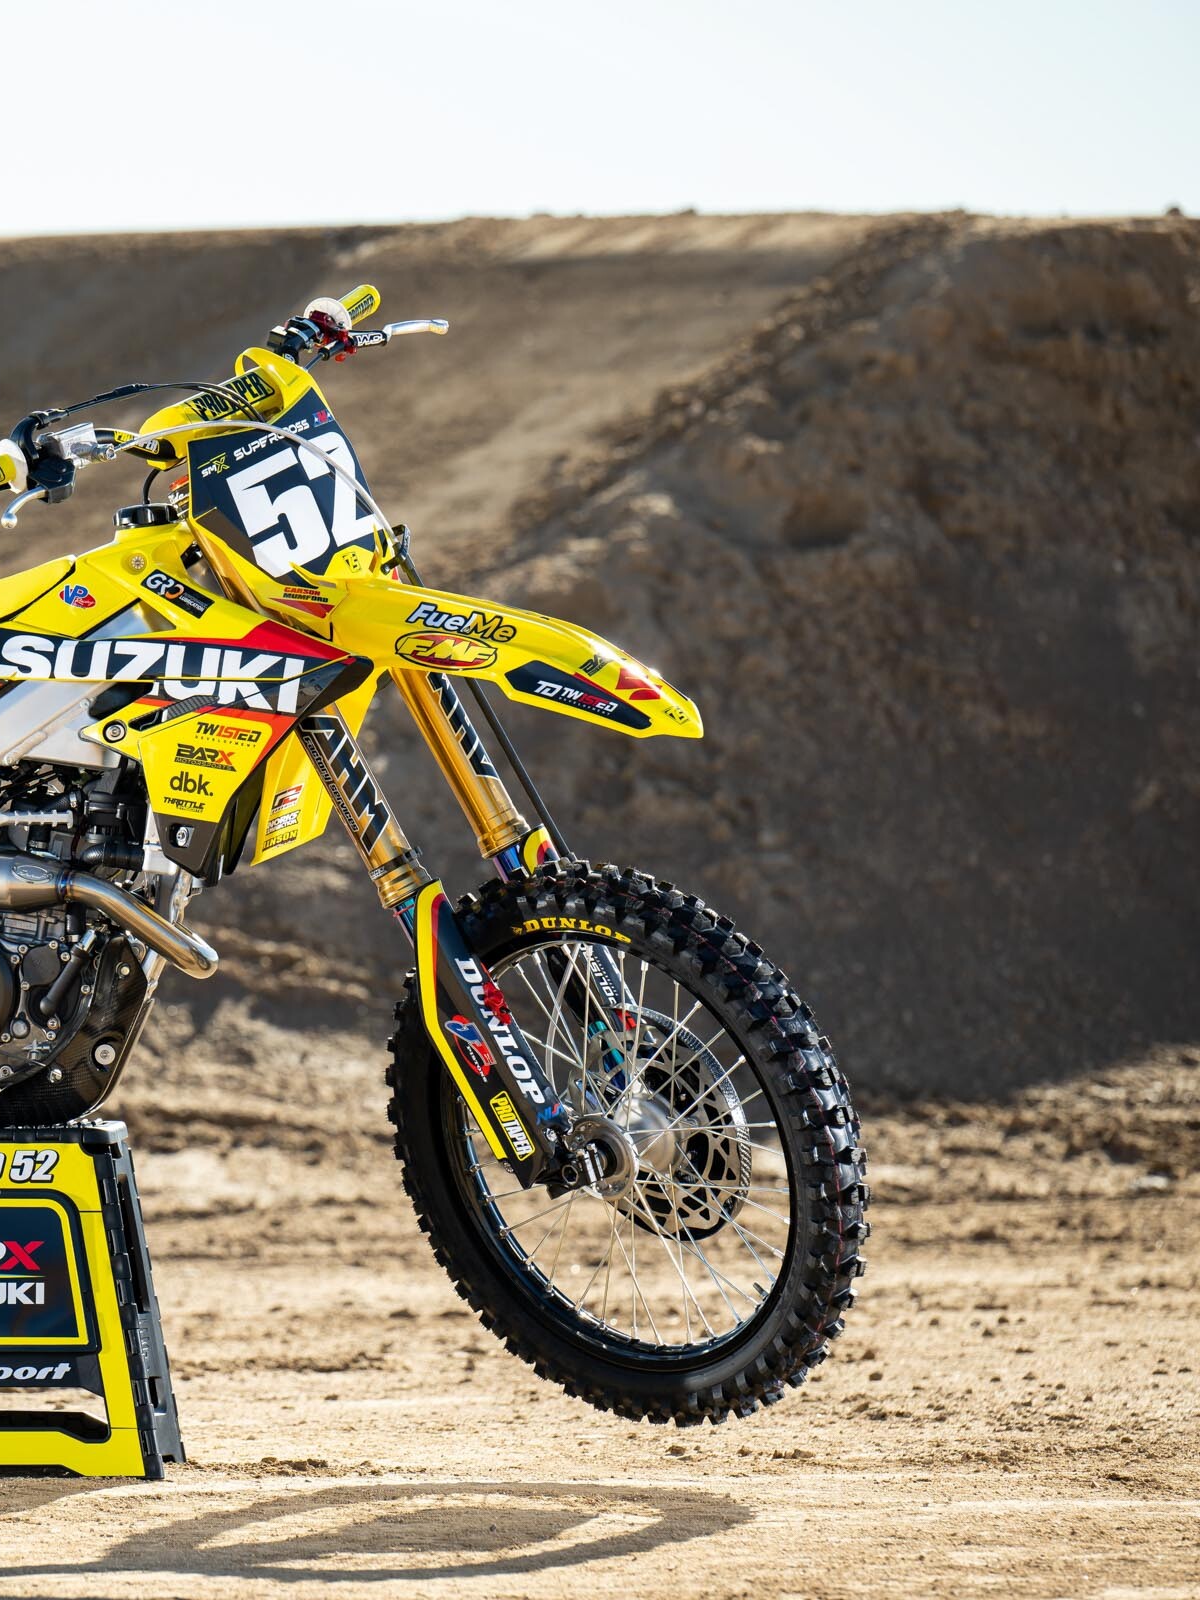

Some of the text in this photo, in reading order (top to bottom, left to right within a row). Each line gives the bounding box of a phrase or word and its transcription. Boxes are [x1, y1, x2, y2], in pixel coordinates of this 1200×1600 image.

[201, 456, 230, 478] SMX
[226, 431, 386, 578] 52
[64, 584, 88, 605] VP
[283, 593, 329, 603] MUMFORD
[284, 586, 321, 596] CARSON
[405, 601, 517, 643] FuelMe
[396, 636, 498, 663] FMF
[560, 687, 619, 713] TWISTED
[196, 721, 263, 743] TWISTED
[175, 743, 236, 766] BARX
[169, 771, 214, 797] dbk.
[163, 796, 206, 810] THROTTLE
[523, 917, 632, 944] DUNLOP
[454, 957, 546, 1104] DUNLOP
[496, 1095, 534, 1160] PROTAPER
[9, 1149, 59, 1183] 52
